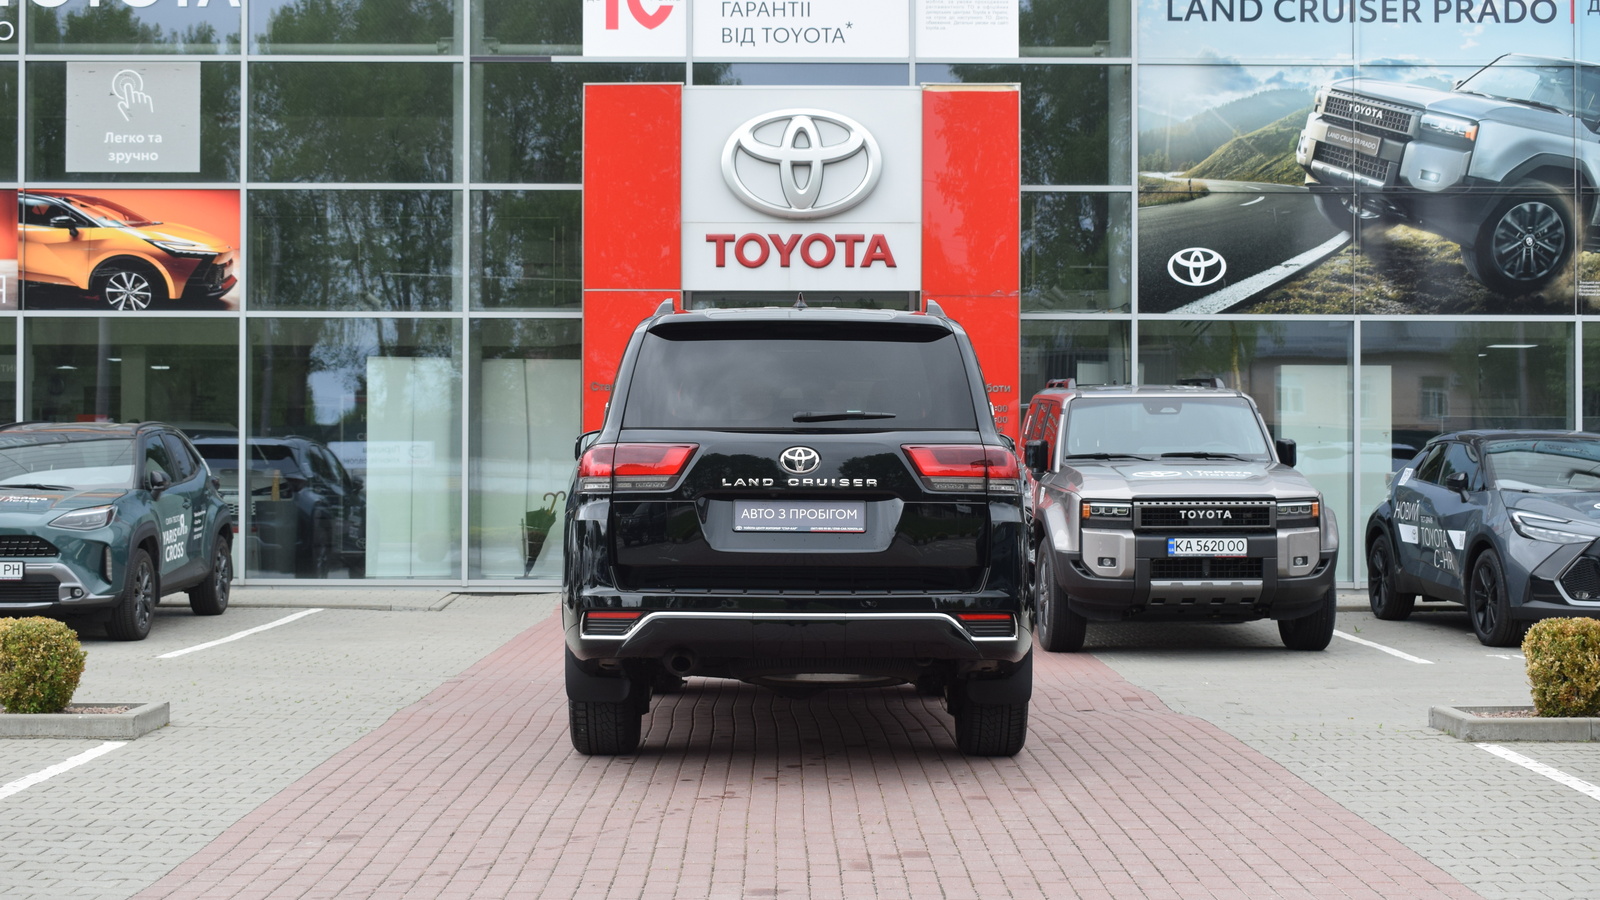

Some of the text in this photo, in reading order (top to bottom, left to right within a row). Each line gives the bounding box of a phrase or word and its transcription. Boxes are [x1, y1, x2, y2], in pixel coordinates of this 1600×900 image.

[1166, 0, 1263, 22] LAND
[1273, 0, 1422, 24] CRUISER
[1434, 0, 1558, 24] PRADO
[721, 27, 756, 47] ВІД
[1348, 103, 1383, 119] TOYOTA
[104, 131, 163, 143] Легко та
[1327, 131, 1340, 140] LAND
[1360, 139, 1377, 150] PRADO
[108, 151, 159, 164] зручно
[705, 232, 898, 269] TOYOTA
[722, 478, 878, 487] LAND CRUISER
[741, 508, 858, 520] АВТО З ПРОБІГОМ
[1179, 510, 1233, 519] TOYOTA
[1393, 500, 1420, 521] НОВИЙ
[162, 528, 177, 546] YARIS
[1421, 527, 1449, 548] TOYOTA
[165, 541, 185, 562] CROSS
[1175, 540, 1194, 552] KA
[1196, 540, 1225, 553] 5620
[1433, 549, 1455, 570] C-HR
[3, 564, 20, 576] PH
